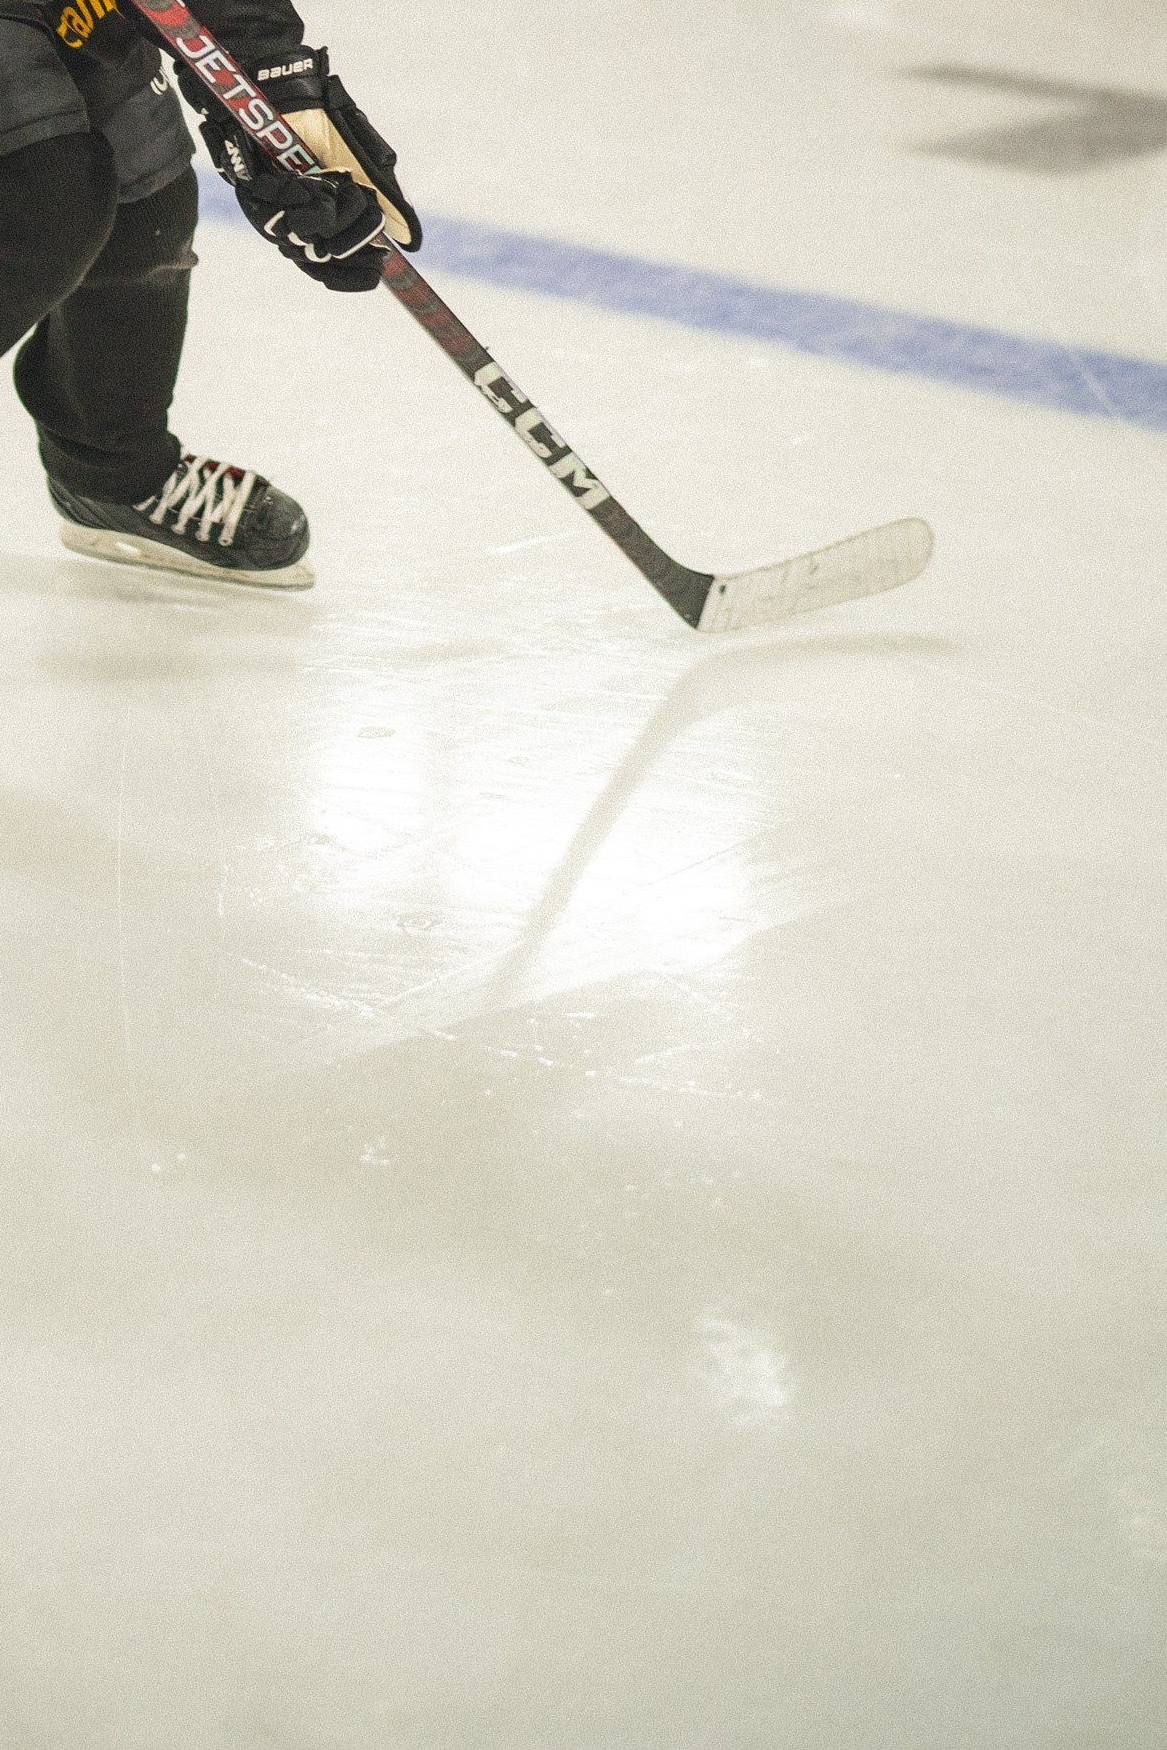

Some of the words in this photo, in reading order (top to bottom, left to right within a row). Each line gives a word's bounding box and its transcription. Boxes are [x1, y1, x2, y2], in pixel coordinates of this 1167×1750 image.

[175, 34, 323, 176] JETSPE
[256, 58, 314, 82] BAUER
[474, 360, 612, 510] CCM
